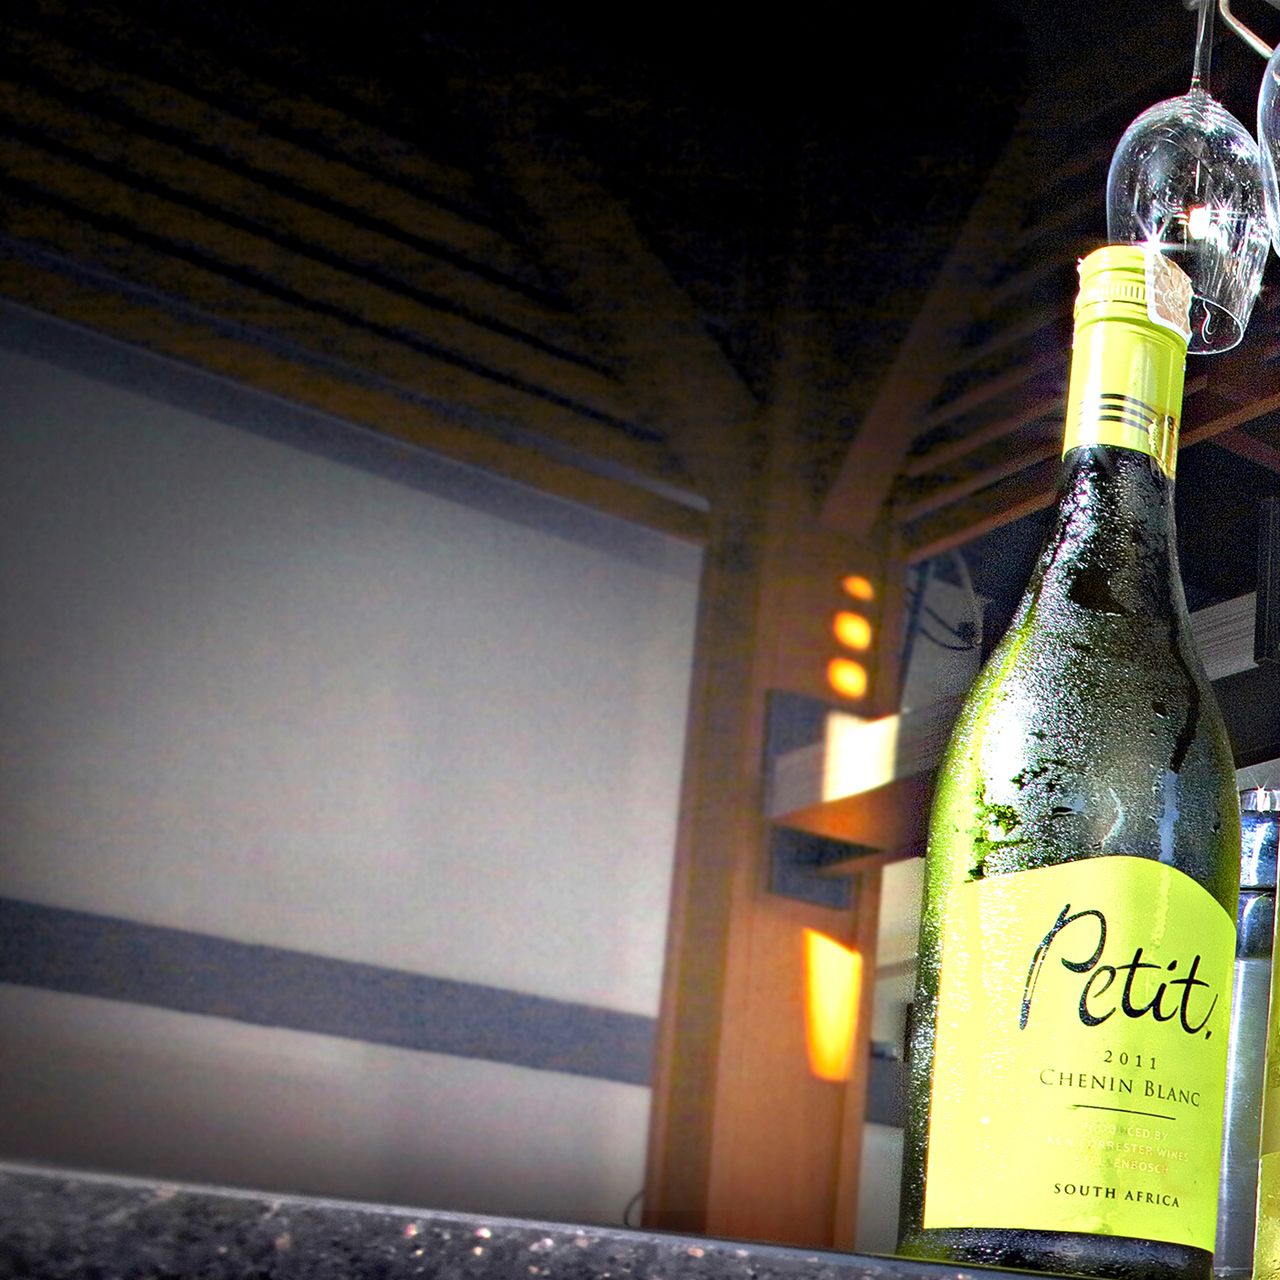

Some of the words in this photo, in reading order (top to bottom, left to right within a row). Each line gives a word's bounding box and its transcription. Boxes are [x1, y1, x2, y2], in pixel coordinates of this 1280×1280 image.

[1104, 1050, 1157, 1070] 2011
[1040, 1069, 1133, 1094] CHENIN
[1145, 1080, 1201, 1107] BLANC
[1054, 1183, 1116, 1199] SOUTH
[1125, 1190, 1180, 1208] AFRICA
